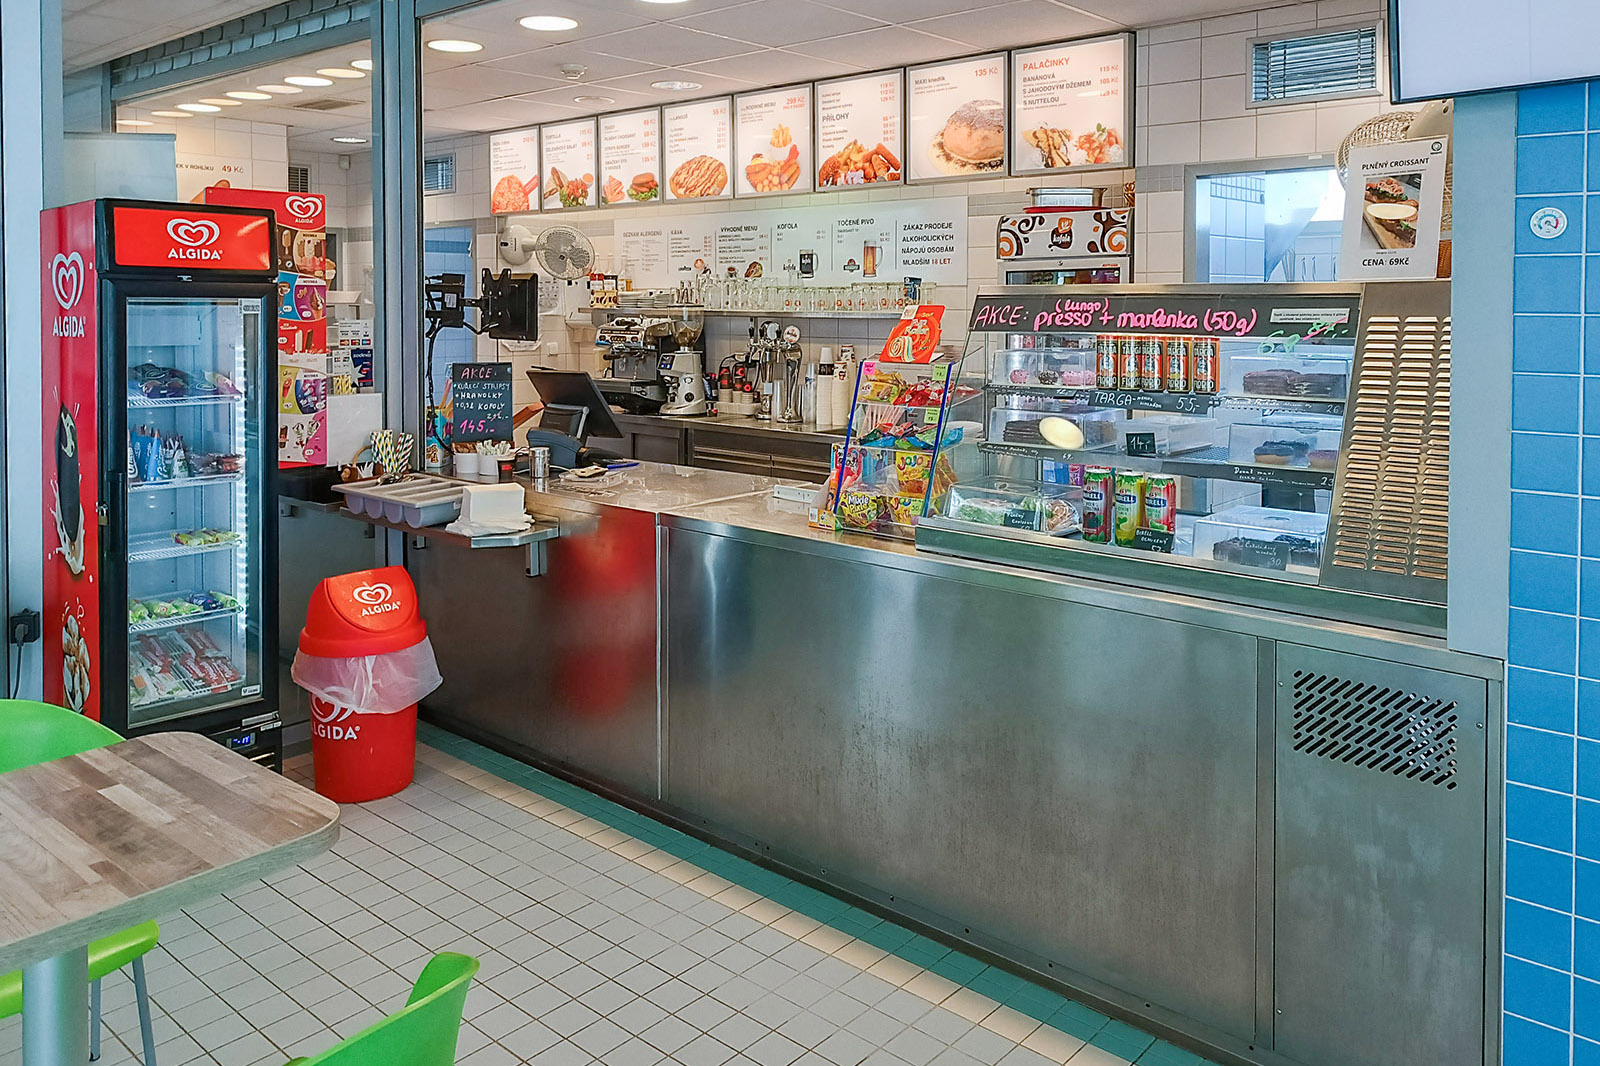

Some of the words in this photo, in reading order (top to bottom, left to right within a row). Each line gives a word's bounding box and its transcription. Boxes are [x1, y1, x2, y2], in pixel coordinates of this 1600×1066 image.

[1022, 57, 1070, 71] PALAČINKY
[975, 68, 987, 77] 135
[1022, 73, 1056, 83] BANÁNOVÁ
[1027, 84, 1065, 94] JAHODOVÝM
[1065, 80, 1092, 89] DŽEMEM
[1027, 96, 1060, 106] NUTTELOU
[822, 112, 850, 122] PŘÍLOHY
[233, 165, 245, 173] Kč
[1361, 160, 1389, 171] PLNĚNÝ
[1389, 157, 1431, 168] CROISSANT
[837, 218, 860, 227] TOČENÉ
[924, 222, 953, 230] PRODEJE
[902, 233, 954, 242] ALKOHOLICKÝCH
[167, 248, 221, 260] ALGIDA
[901, 245, 926, 254] NÁPOJŮ
[926, 245, 955, 253] OSOBÁM
[902, 257, 930, 265] MLADŠÍM
[1362, 258, 1388, 267] CENA:
[1388, 257, 1410, 266] 69Kč
[1055, 297, 1110, 313] (lungo)
[972, 304, 1030, 331] AKCE:
[1033, 311, 1092, 332] presso
[1203, 308, 1258, 336] (50g)
[52, 316, 86, 338] ALGIDA
[482, 382, 510, 391] STRIPSY
[1175, 397, 1200, 413] 55,-
[1130, 436, 1151, 450] 14,-
[897, 455, 925, 470] JOJO
[361, 603, 400, 617] ALGIDA
[312, 723, 358, 741] LGIDA
